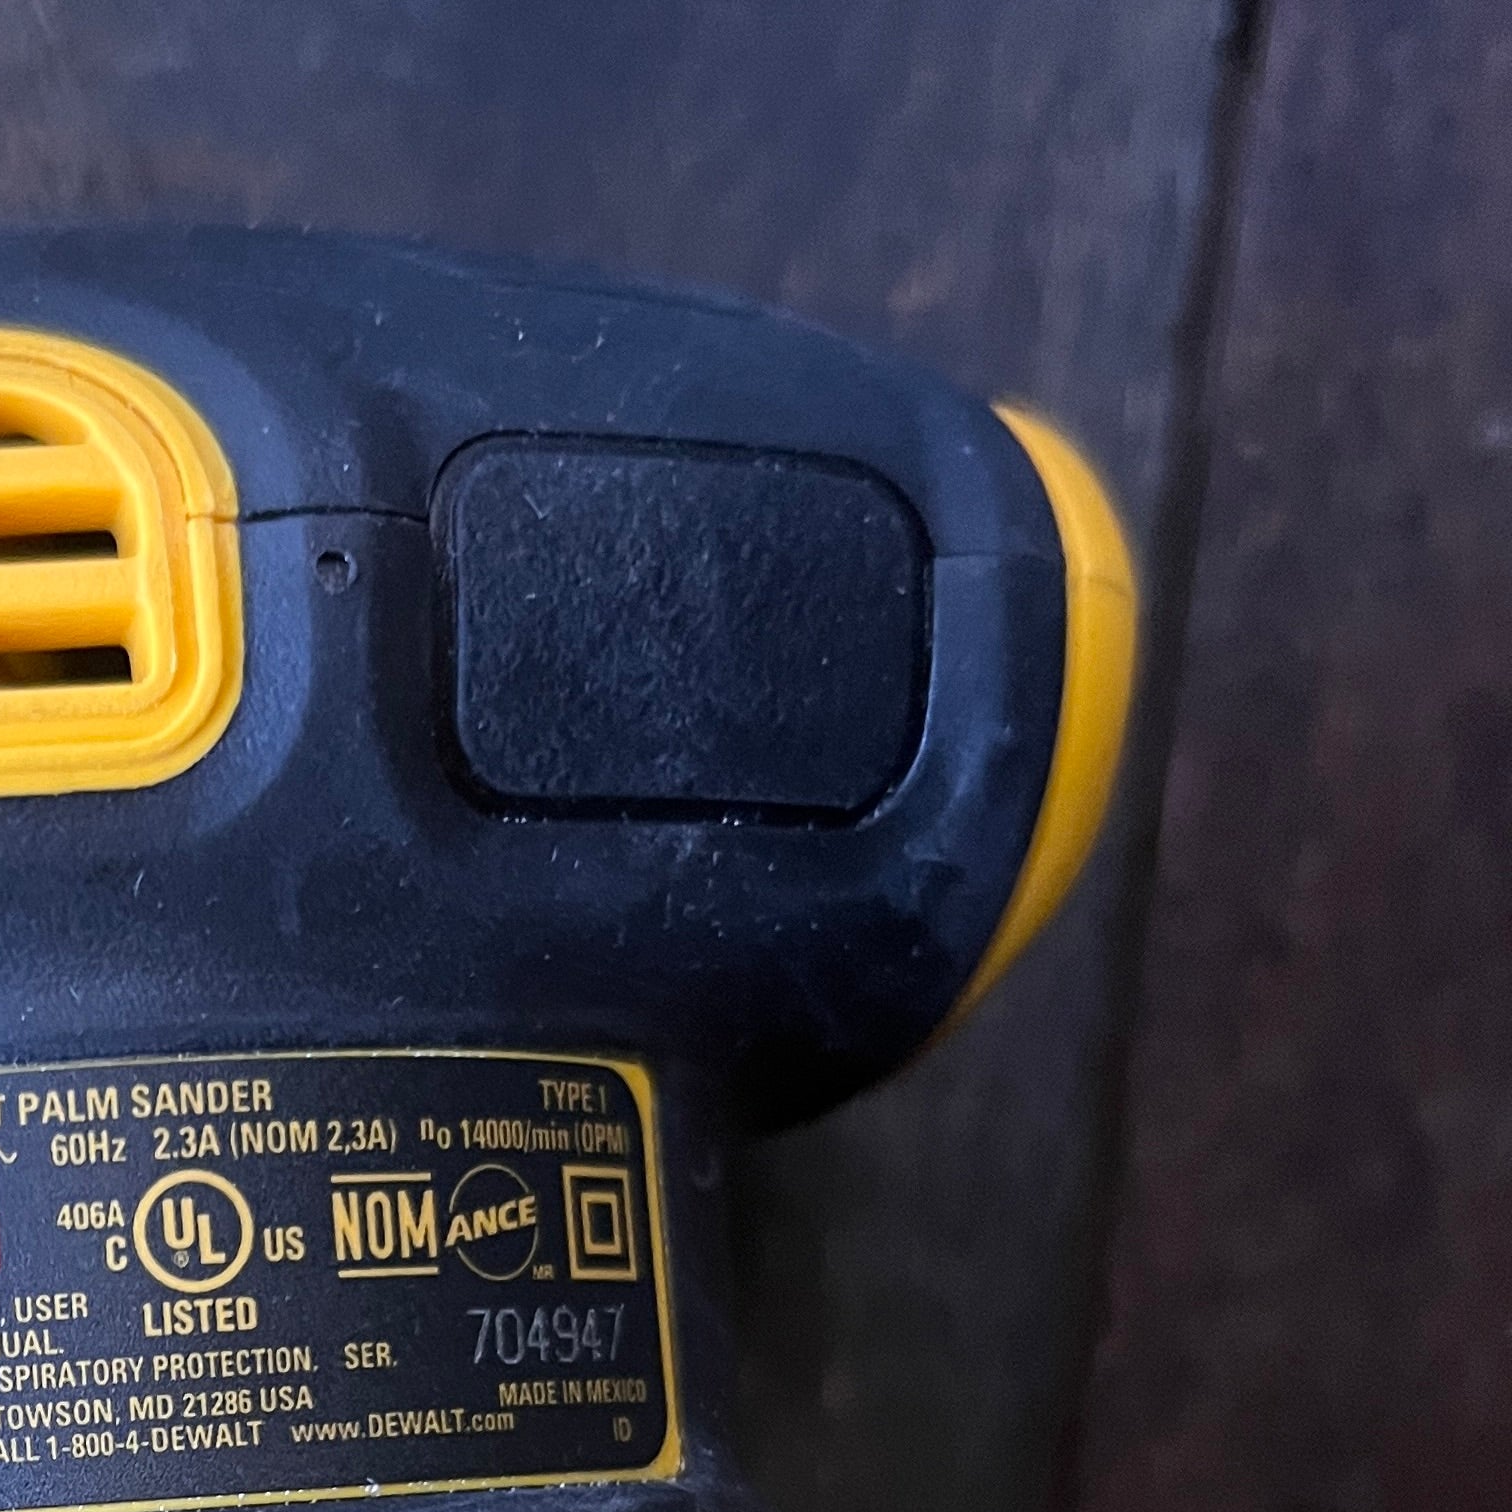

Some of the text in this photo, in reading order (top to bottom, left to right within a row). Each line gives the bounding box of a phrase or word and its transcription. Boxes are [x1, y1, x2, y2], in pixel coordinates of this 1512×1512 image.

[18, 1086, 119, 1126] PALM
[131, 1079, 273, 1119] SANDER
[539, 1079, 593, 1113] TYPE
[50, 1129, 127, 1167] 60Hz
[153, 1124, 220, 1160] 2.3A
[230, 1120, 318, 1160] (NOM
[327, 1119, 397, 1155] 2,3A)
[460, 1118, 570, 1154] 14000/min
[57, 1200, 125, 1231] 406A
[162, 1197, 226, 1265] UL
[331, 1189, 438, 1261] NOM
[445, 1195, 537, 1248] ANCE
[105, 1235, 128, 1272] C
[264, 1226, 306, 1262] US
[14, 1293, 88, 1323] USER
[142, 1297, 258, 1337] LISTED
[466, 1302, 625, 1365] 704947
[153, 1346, 319, 1382] PROTECTION.
[344, 1342, 398, 1370] SER.
[129, 1394, 174, 1421] MD
[182, 1389, 252, 1418] 21286
[259, 1385, 314, 1413] USA
[498, 1378, 647, 1407] MADE IN MEXICO
[46, 1420, 265, 1461] 1-800-4-DEWALT
[291, 1408, 514, 1443] www.DEWALT.com
